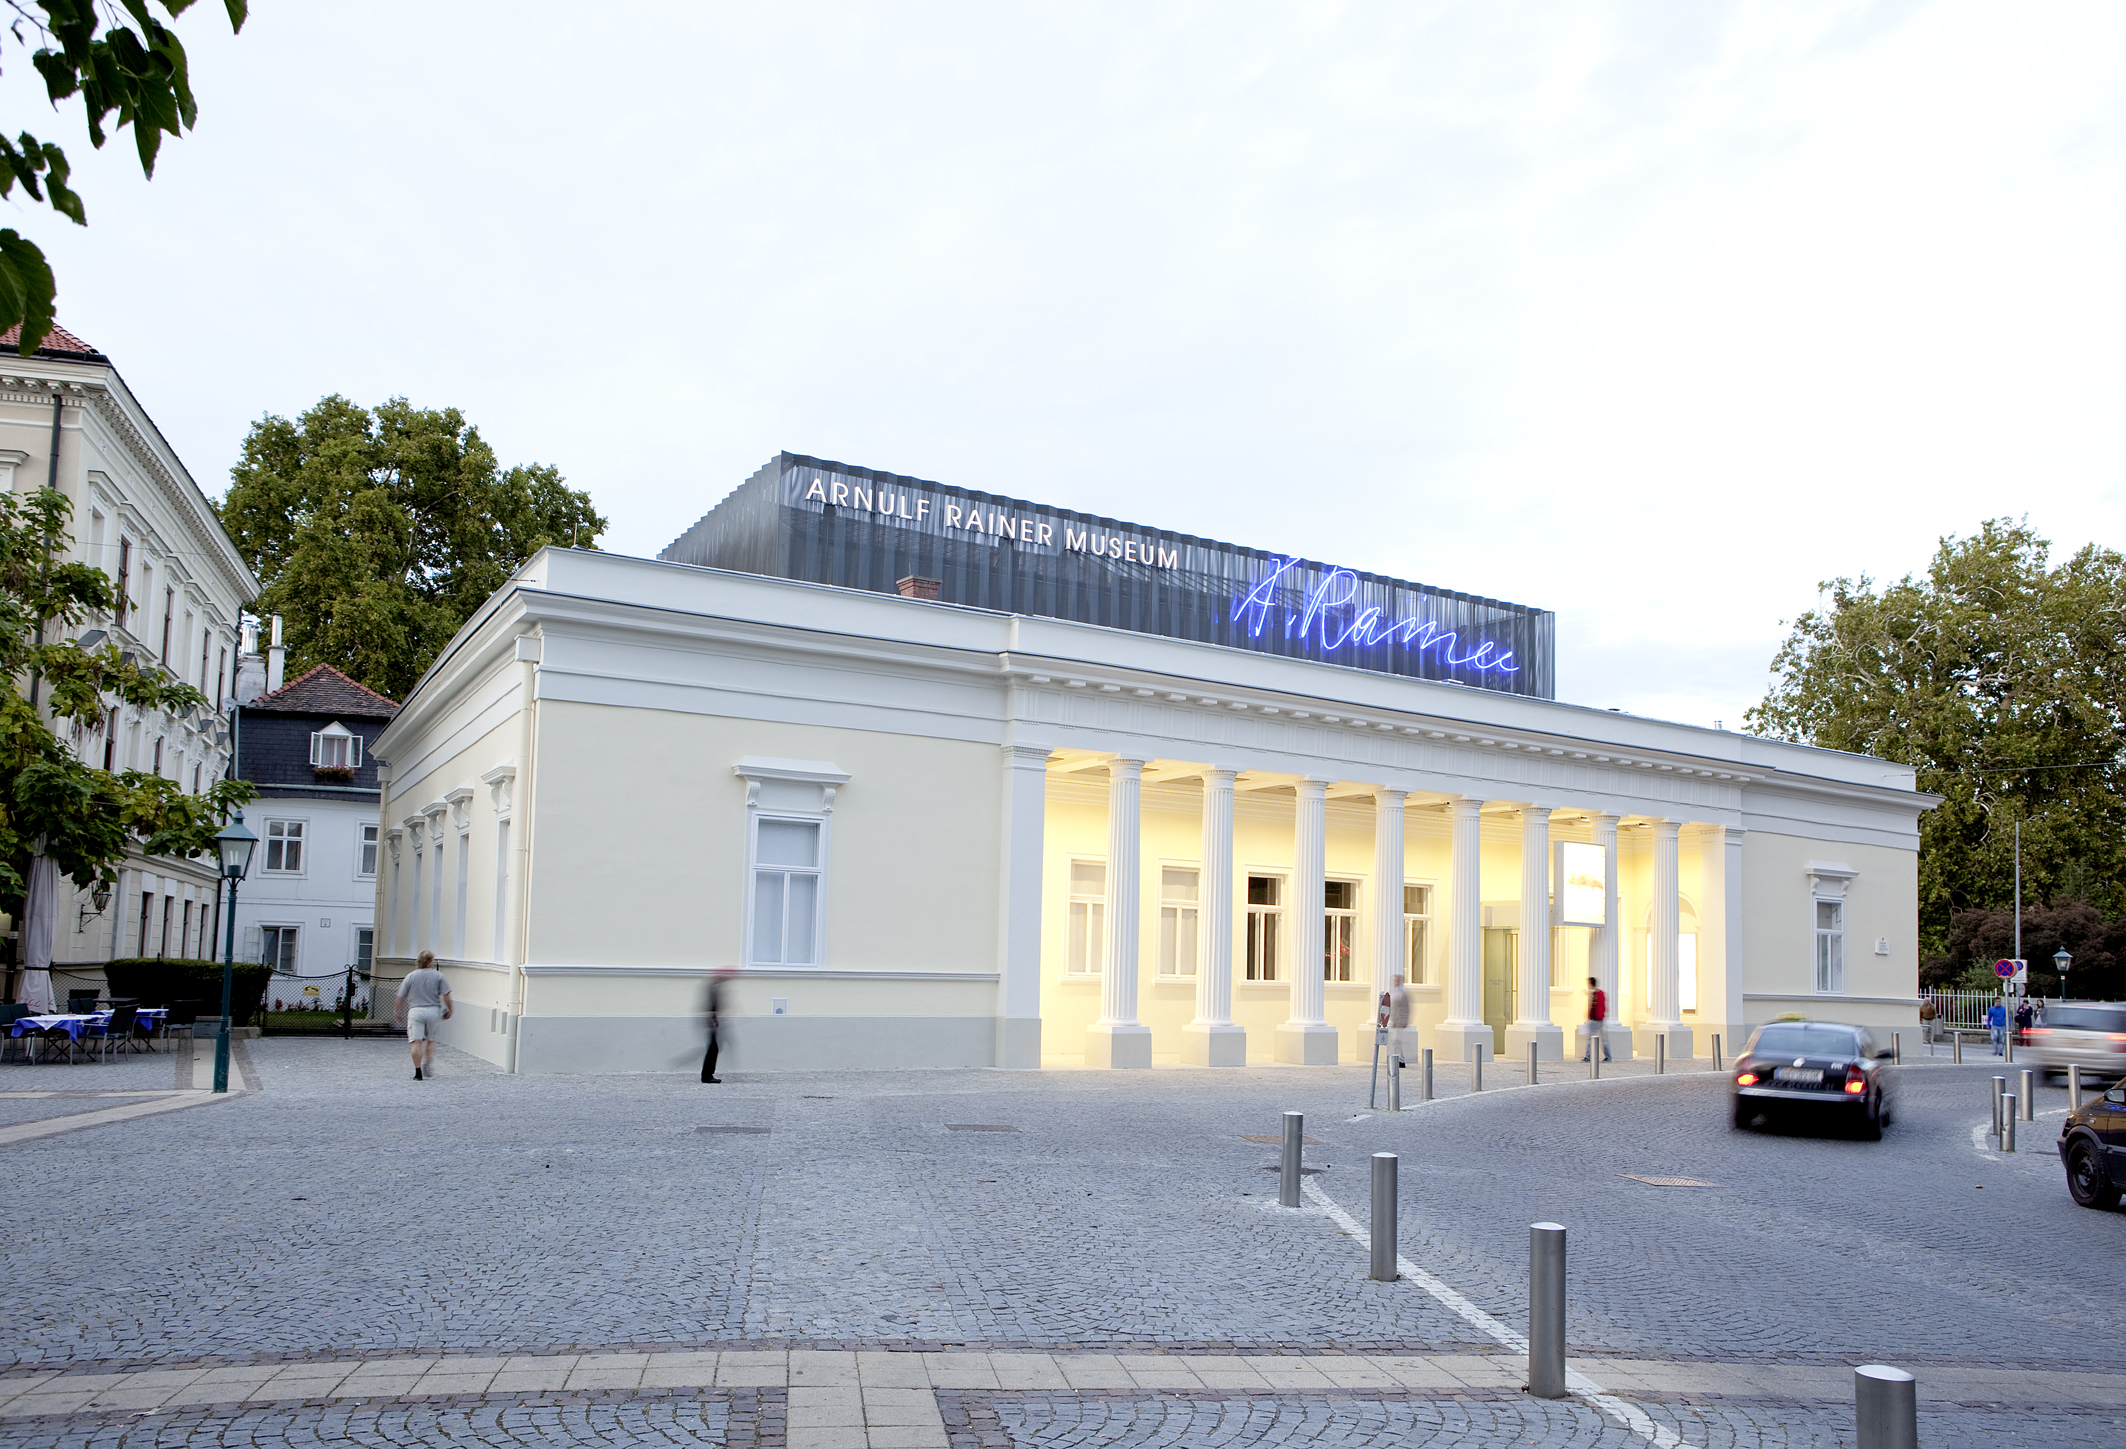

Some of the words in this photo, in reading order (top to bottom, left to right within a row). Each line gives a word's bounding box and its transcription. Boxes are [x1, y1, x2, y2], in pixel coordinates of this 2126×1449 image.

[804, 477, 931, 523] ARNULF
[940, 503, 1053, 547] RAINER
[1064, 527, 1179, 571] MUSEUM
